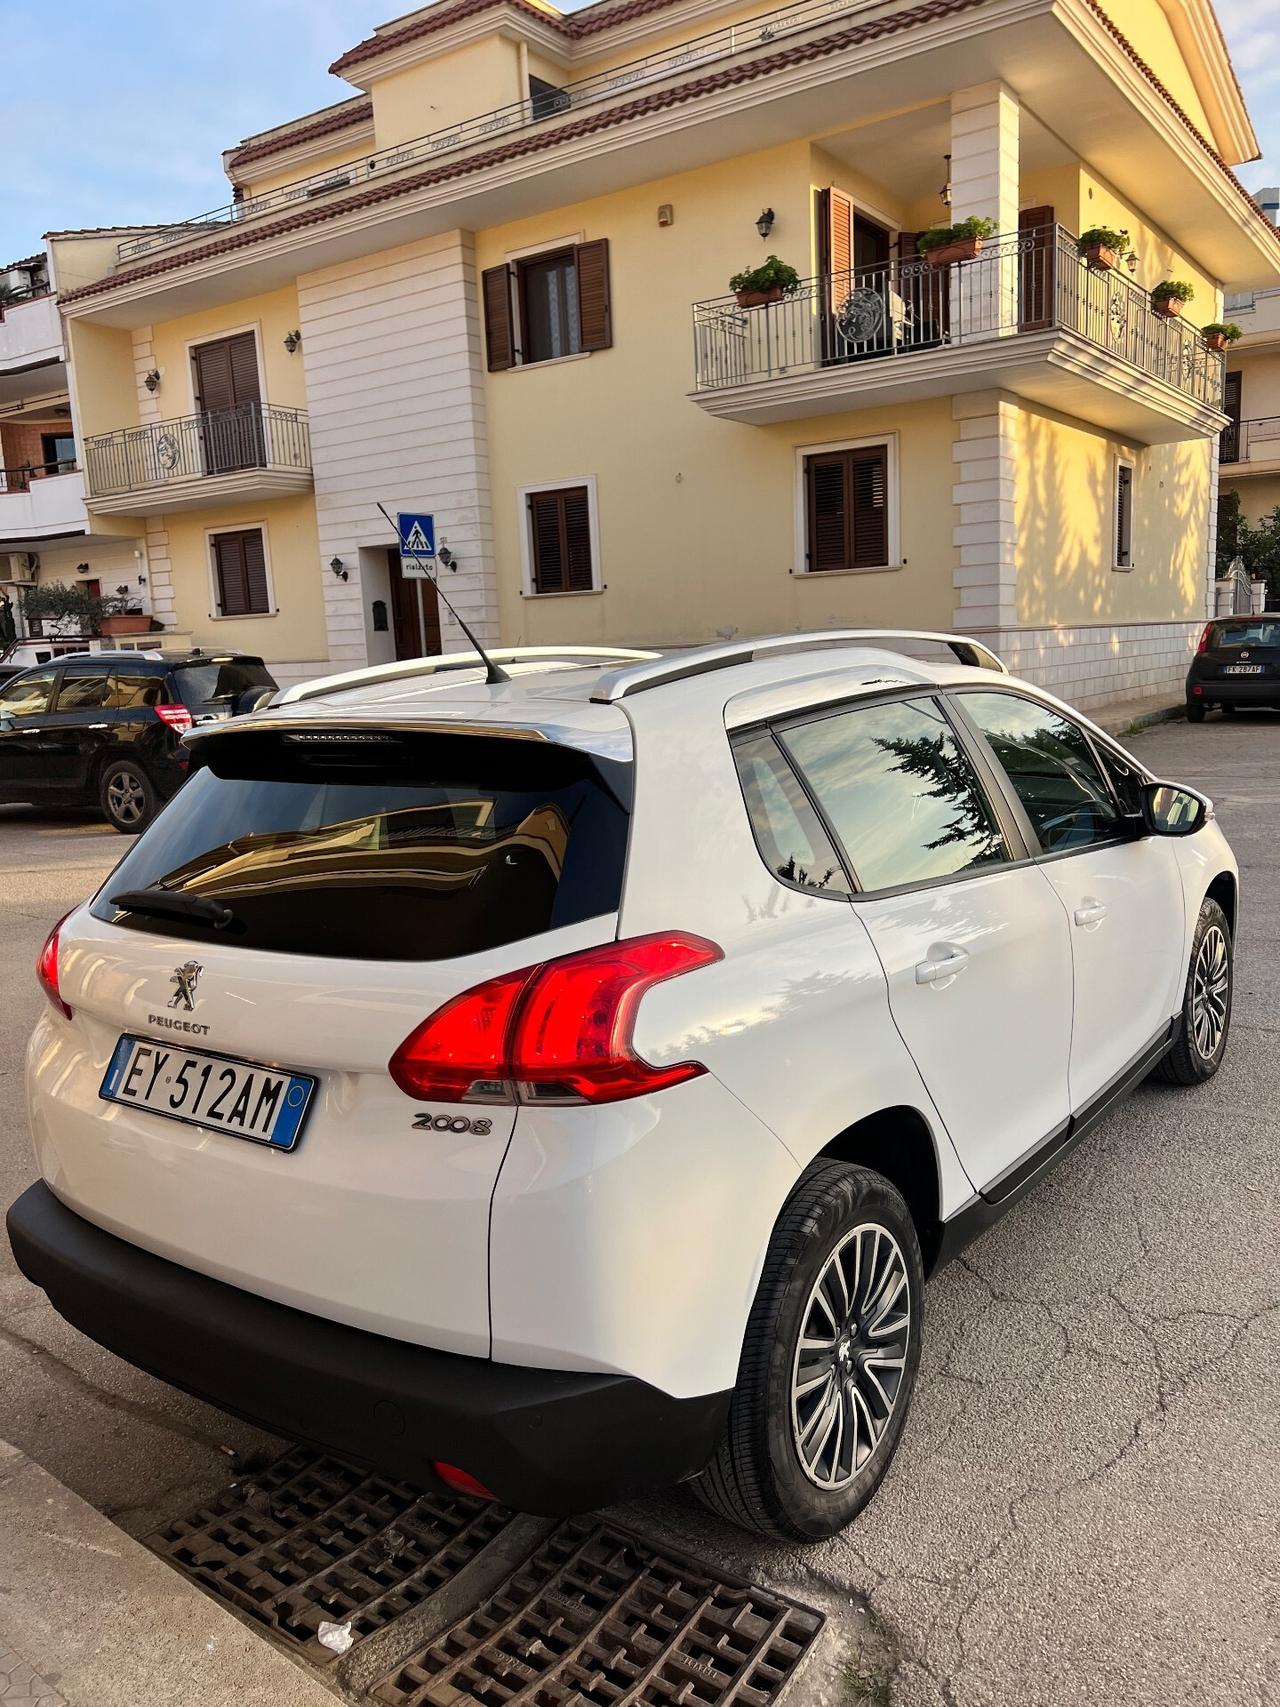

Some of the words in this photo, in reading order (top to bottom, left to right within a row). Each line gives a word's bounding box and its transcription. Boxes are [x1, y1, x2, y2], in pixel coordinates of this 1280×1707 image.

[148, 1014, 210, 1035] PEUGEOT
[122, 1047, 170, 1100] EY
[169, 1059, 284, 1133] 512AM
[411, 1112, 493, 1136] 2008
